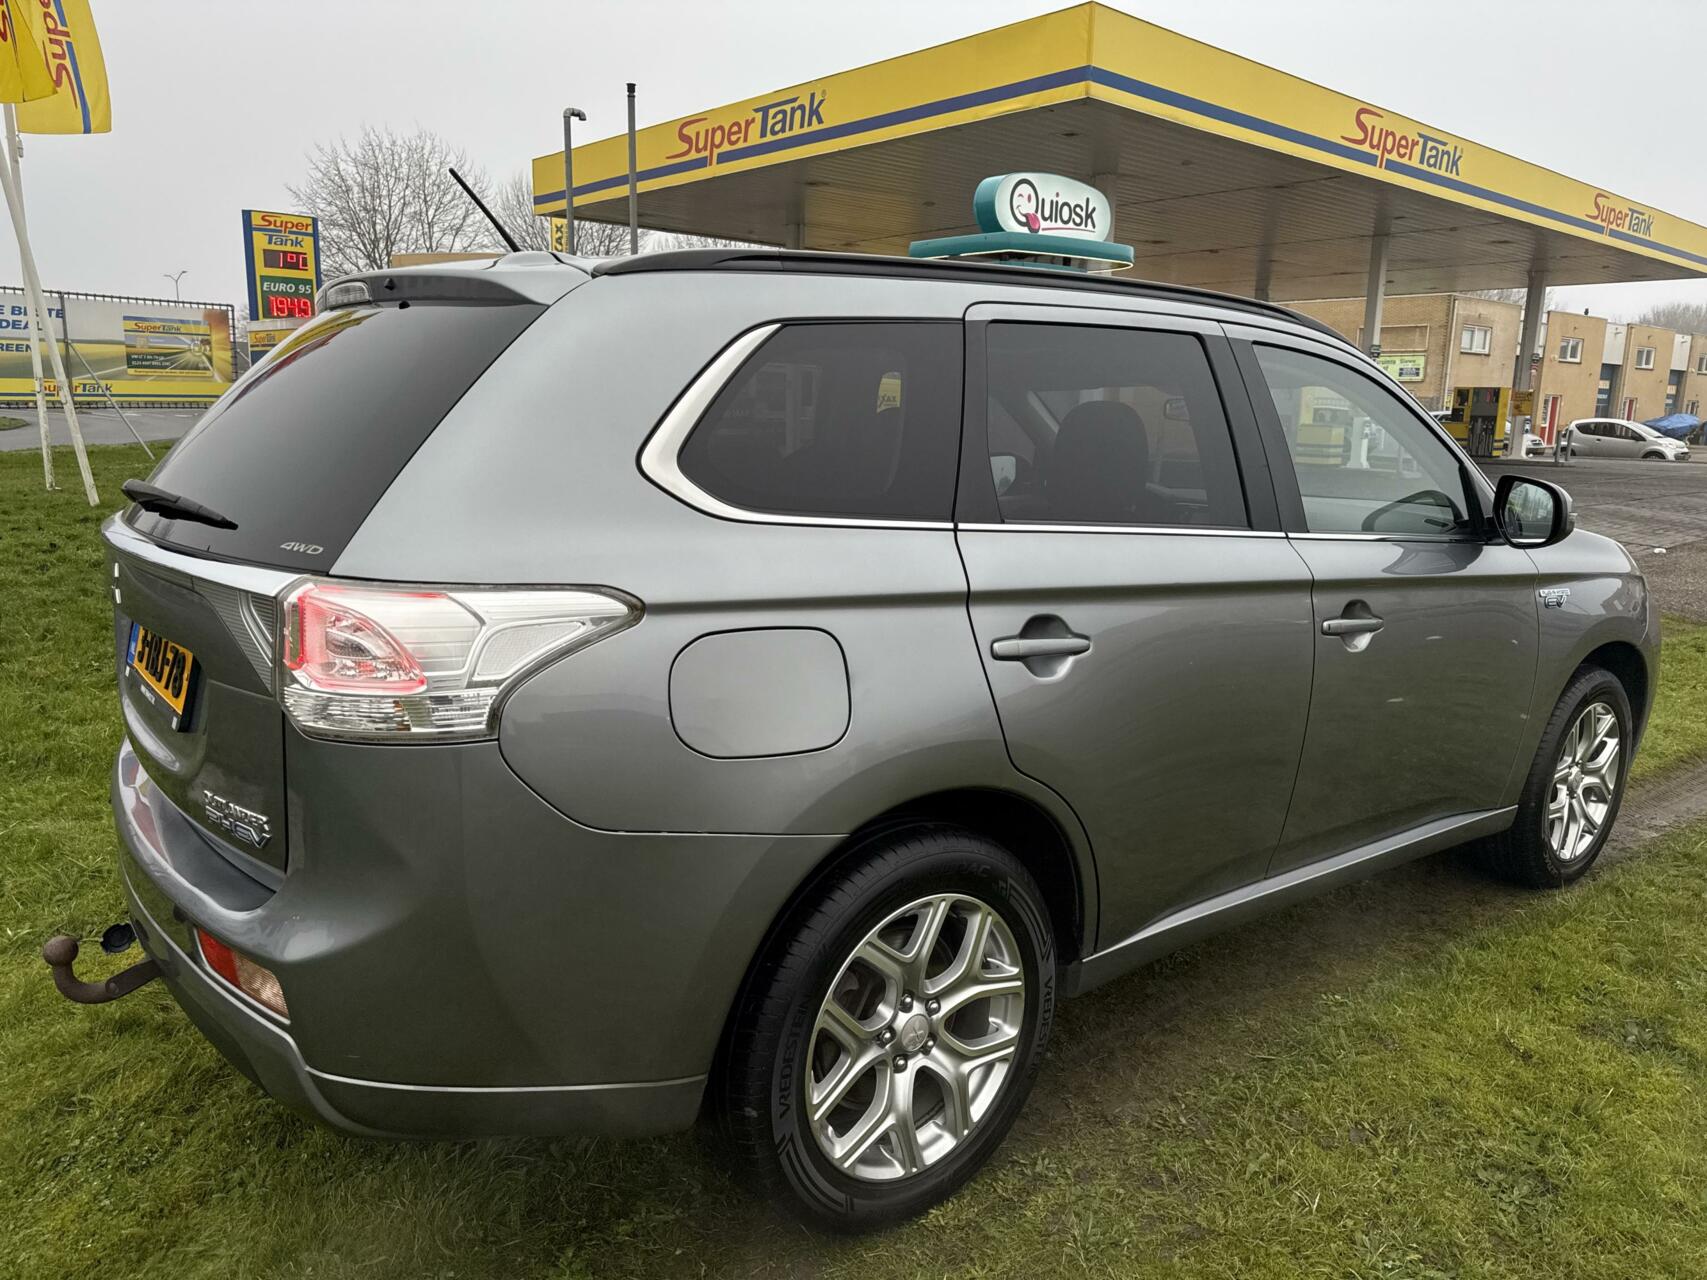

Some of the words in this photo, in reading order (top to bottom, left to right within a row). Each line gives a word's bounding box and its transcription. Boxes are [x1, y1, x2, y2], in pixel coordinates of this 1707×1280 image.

[666, 91, 826, 167] SuperTank
[1340, 107, 1463, 177] SuperTank
[1009, 178, 1097, 234] Quiosk
[254, 214, 312, 234] Super
[262, 233, 305, 248] Tank
[262, 281, 296, 293] EURO
[298, 284, 312, 294] 95
[11, 305, 63, 318] BTE
[280, 542, 324, 555] 4WD
